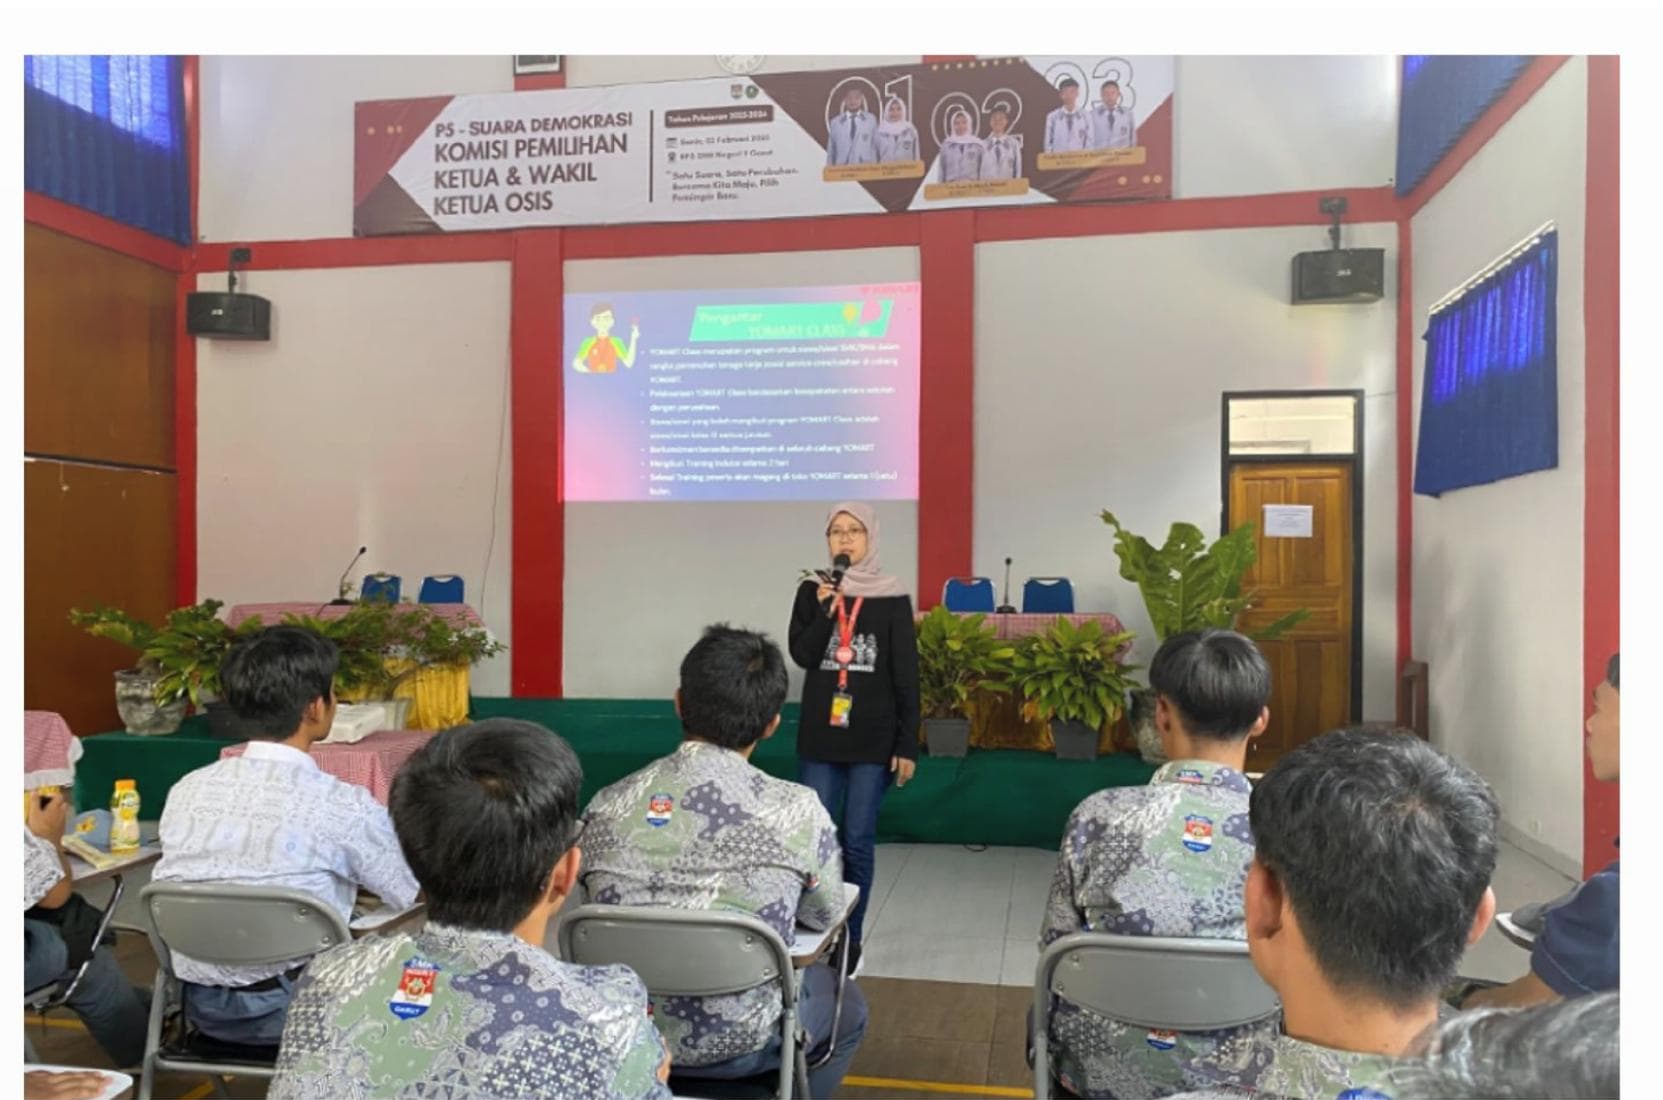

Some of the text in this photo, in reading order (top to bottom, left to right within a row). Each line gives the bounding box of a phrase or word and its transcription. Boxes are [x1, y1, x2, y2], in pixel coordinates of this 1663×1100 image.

[436, 122, 453, 138] P5
[469, 118, 526, 137] SUARA
[531, 112, 633, 133] DEMOKRASI
[436, 133, 628, 163] KOMISI PEMILIHAN
[435, 162, 597, 190] KETUA & WAKIL
[434, 191, 553, 216] KETUA OSIS
